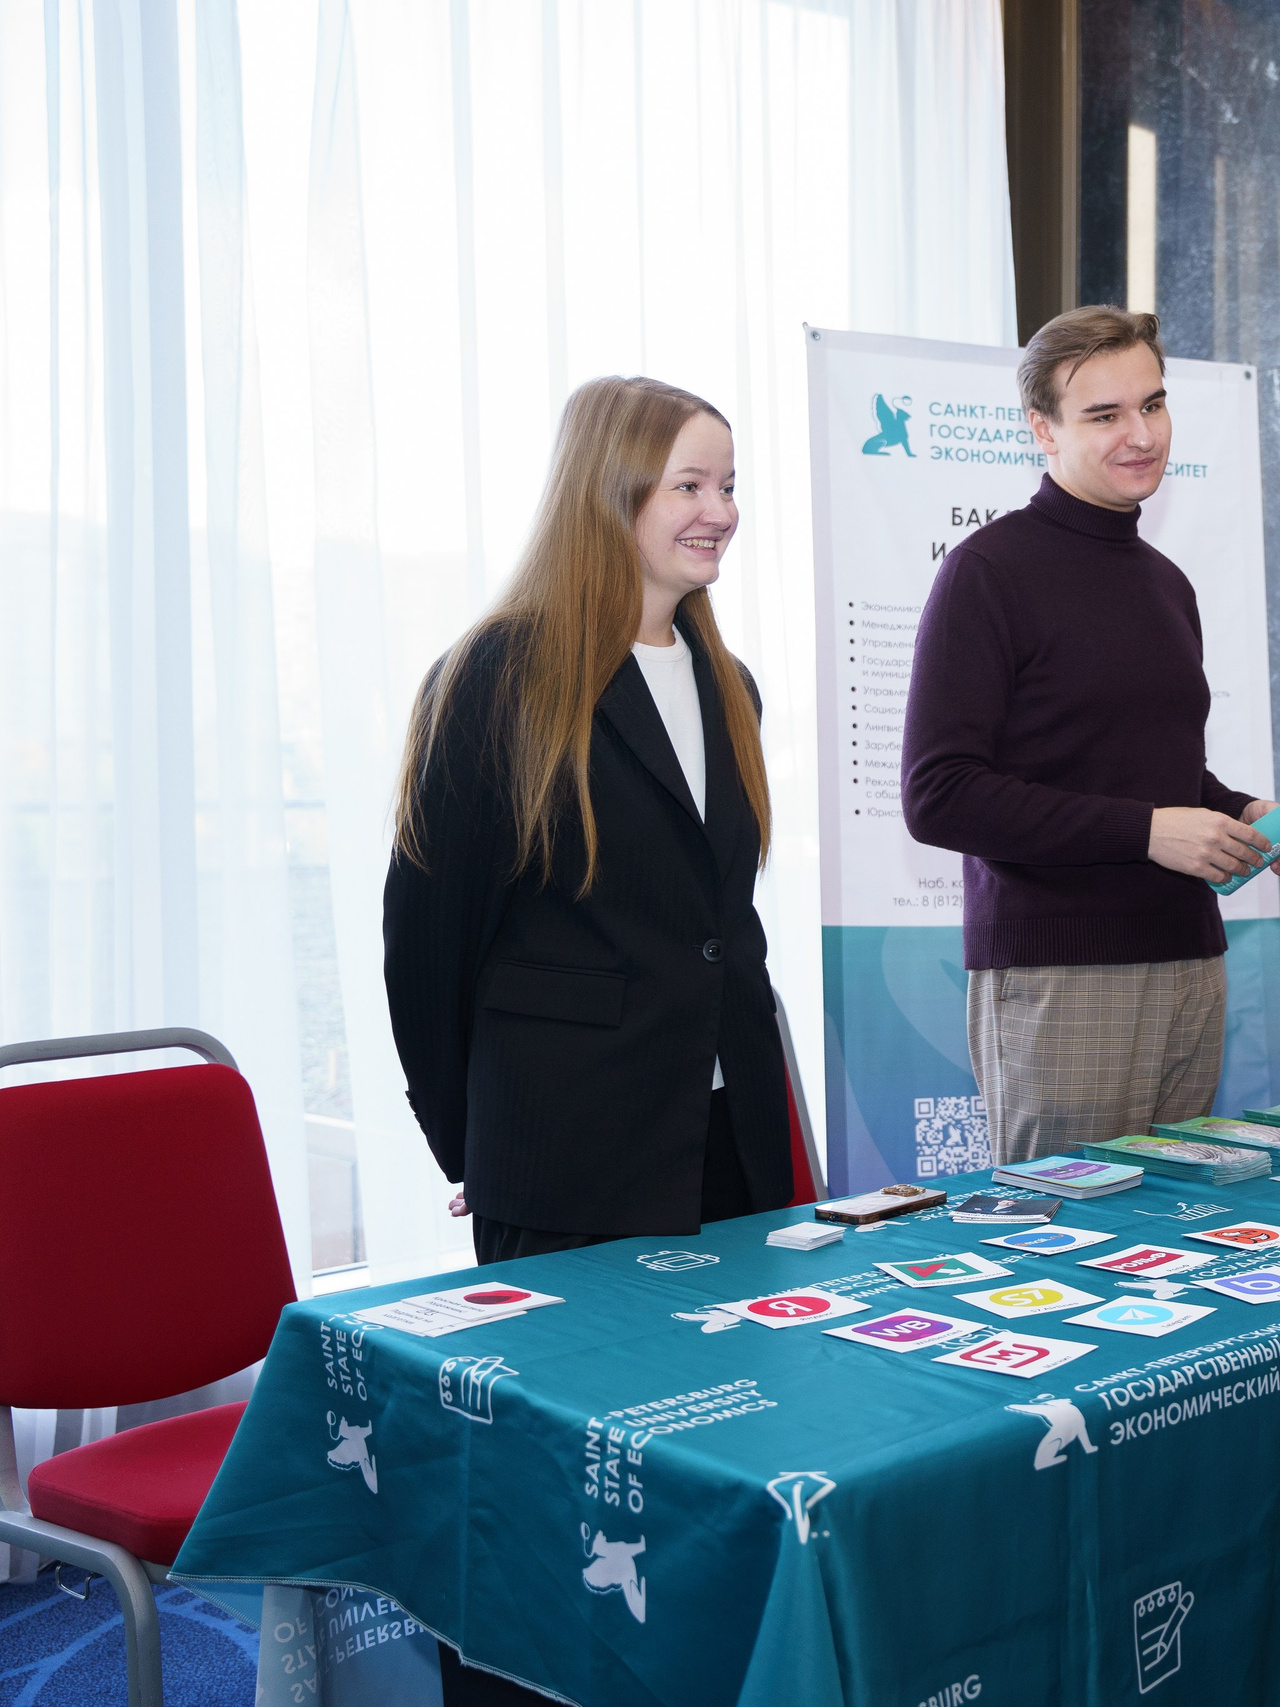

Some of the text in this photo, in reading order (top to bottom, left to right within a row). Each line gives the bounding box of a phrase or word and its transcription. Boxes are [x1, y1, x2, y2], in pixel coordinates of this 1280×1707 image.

[930, 446, 1046, 467] ЭКОНОМИЧЕ
[952, 507, 1010, 526] БАК
[864, 686, 908, 697] Управле
[919, 877, 948, 889] Наб.
[922, 895, 929, 906] 8
[1111, 1252, 1166, 1270] РОЛЬФ
[1001, 1289, 1044, 1306] S7
[870, 1320, 931, 1337] WB
[336, 1329, 354, 1397] STATE
[355, 1367, 368, 1402] OF
[1109, 1366, 1280, 1446] ЭКОНОМИЧЕСКИЙ
[585, 1379, 758, 1500] SAINT-PETERSBURG
[604, 1389, 762, 1508] STATE UNIVERSITY
[627, 1399, 778, 1514] OF ECONOMICS
